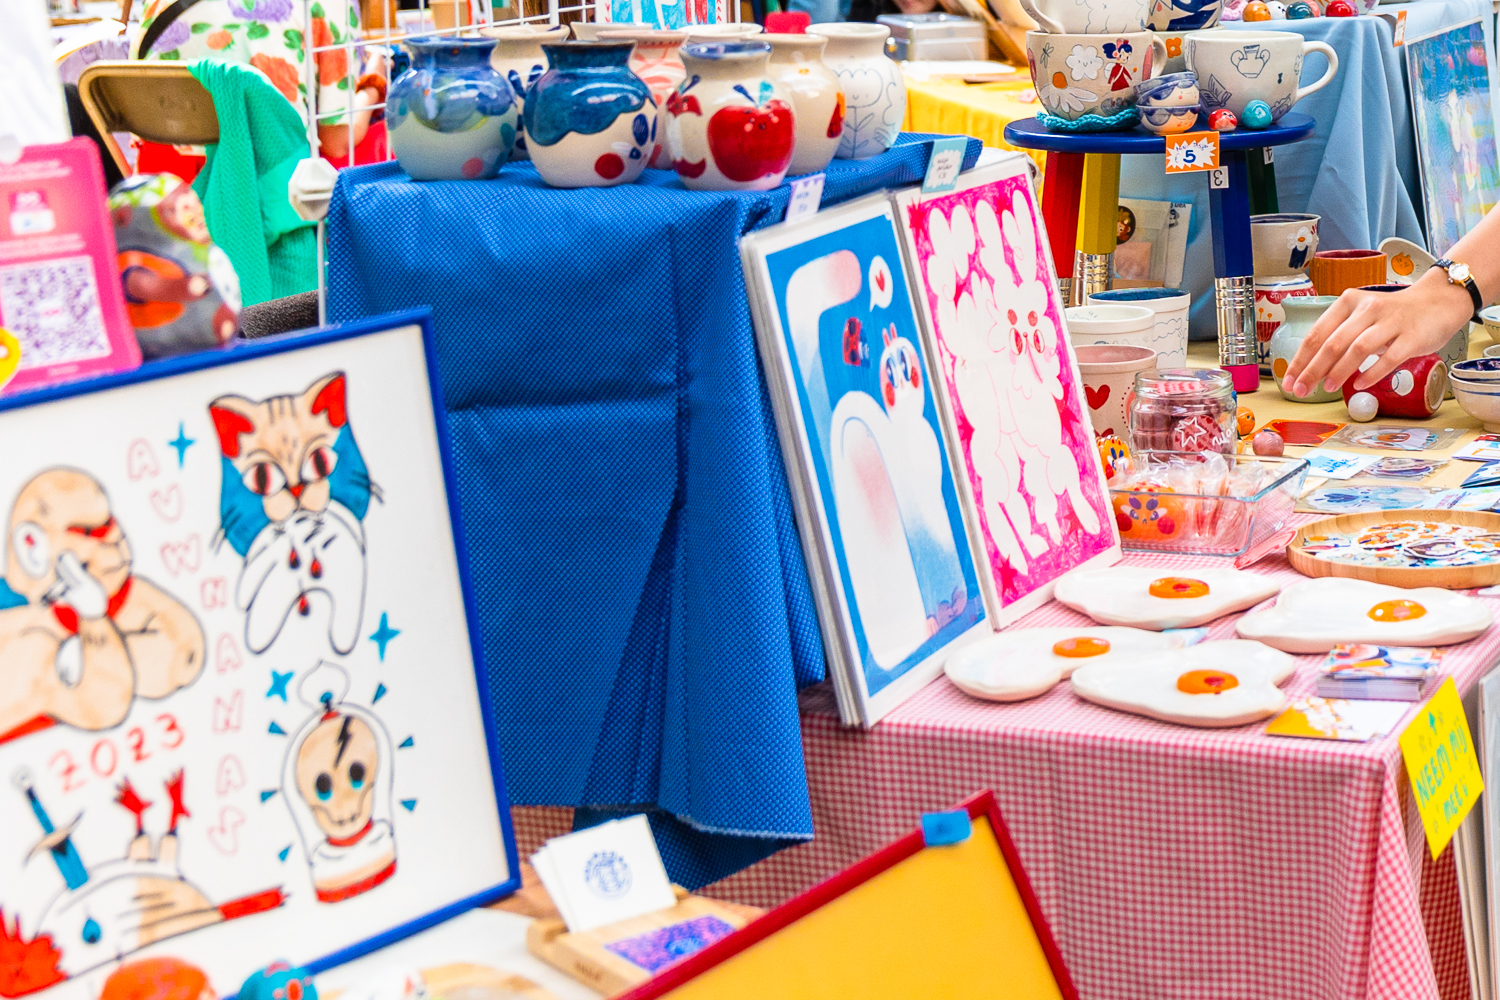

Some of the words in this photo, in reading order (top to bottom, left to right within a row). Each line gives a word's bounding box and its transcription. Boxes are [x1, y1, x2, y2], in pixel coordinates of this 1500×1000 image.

[1182, 149, 1197, 164] 5
[48, 713, 186, 794] 2023
[1415, 744, 1452, 810] NEEM
